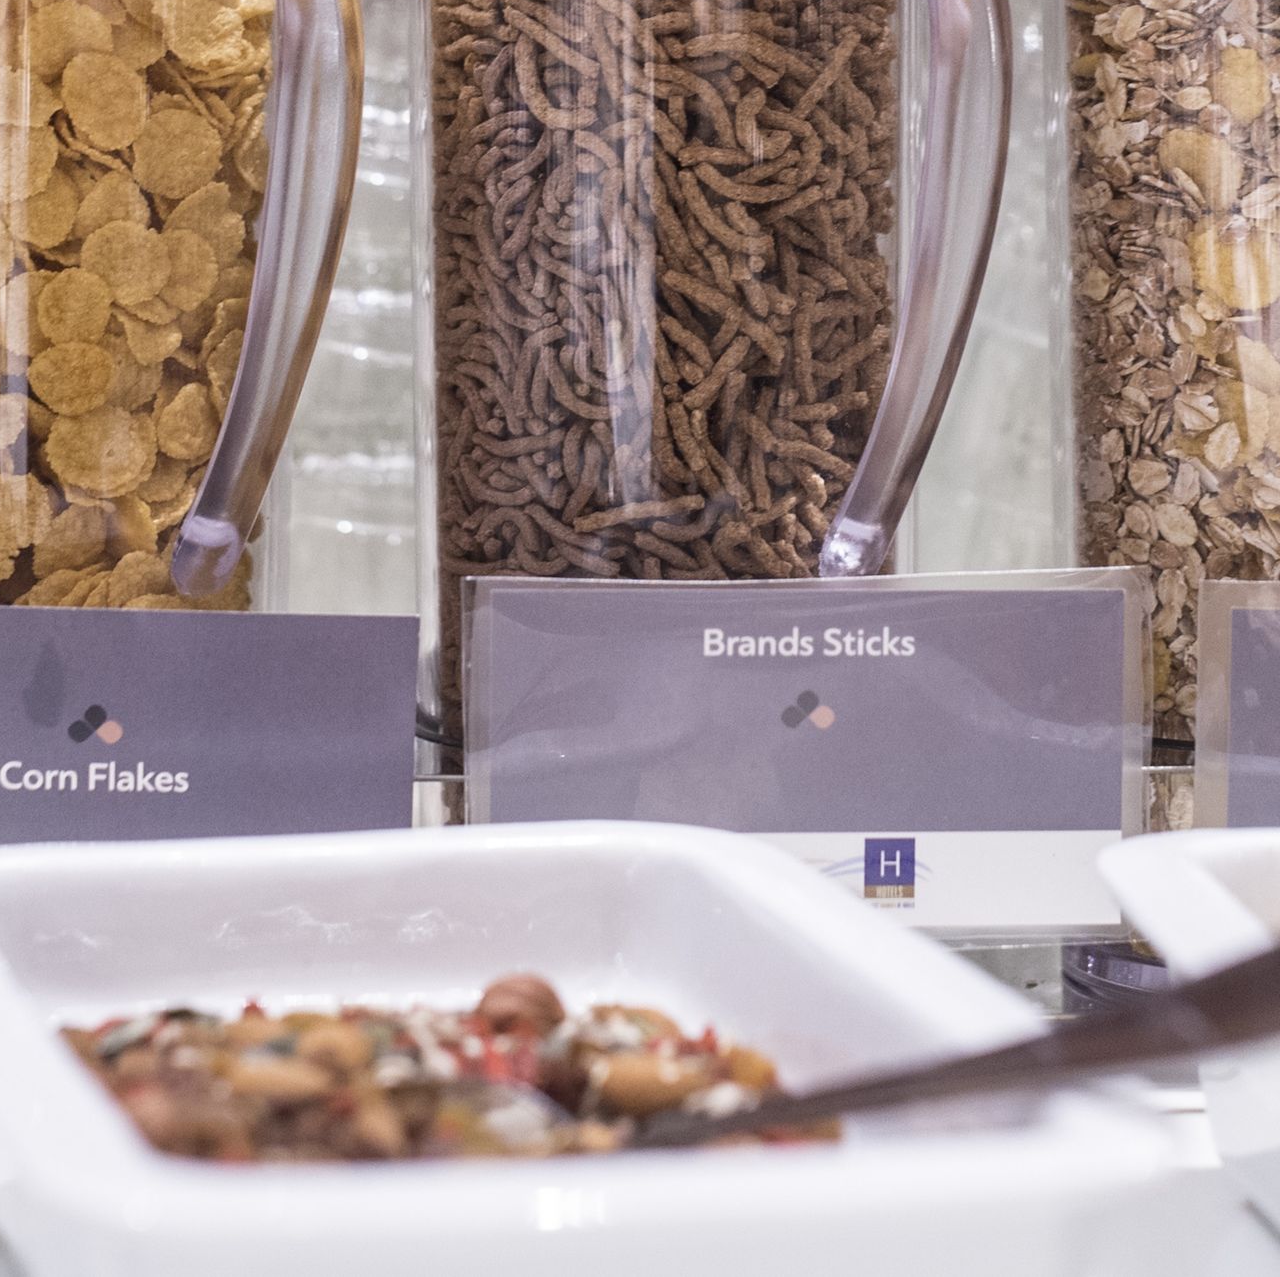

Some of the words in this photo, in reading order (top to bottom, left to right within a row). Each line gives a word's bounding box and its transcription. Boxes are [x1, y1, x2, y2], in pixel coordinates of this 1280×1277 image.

[703, 626, 814, 657] Brands
[823, 626, 916, 657] Sticks
[0, 760, 78, 791] Corn
[87, 761, 189, 793] Flakes
[879, 849, 901, 878] H
